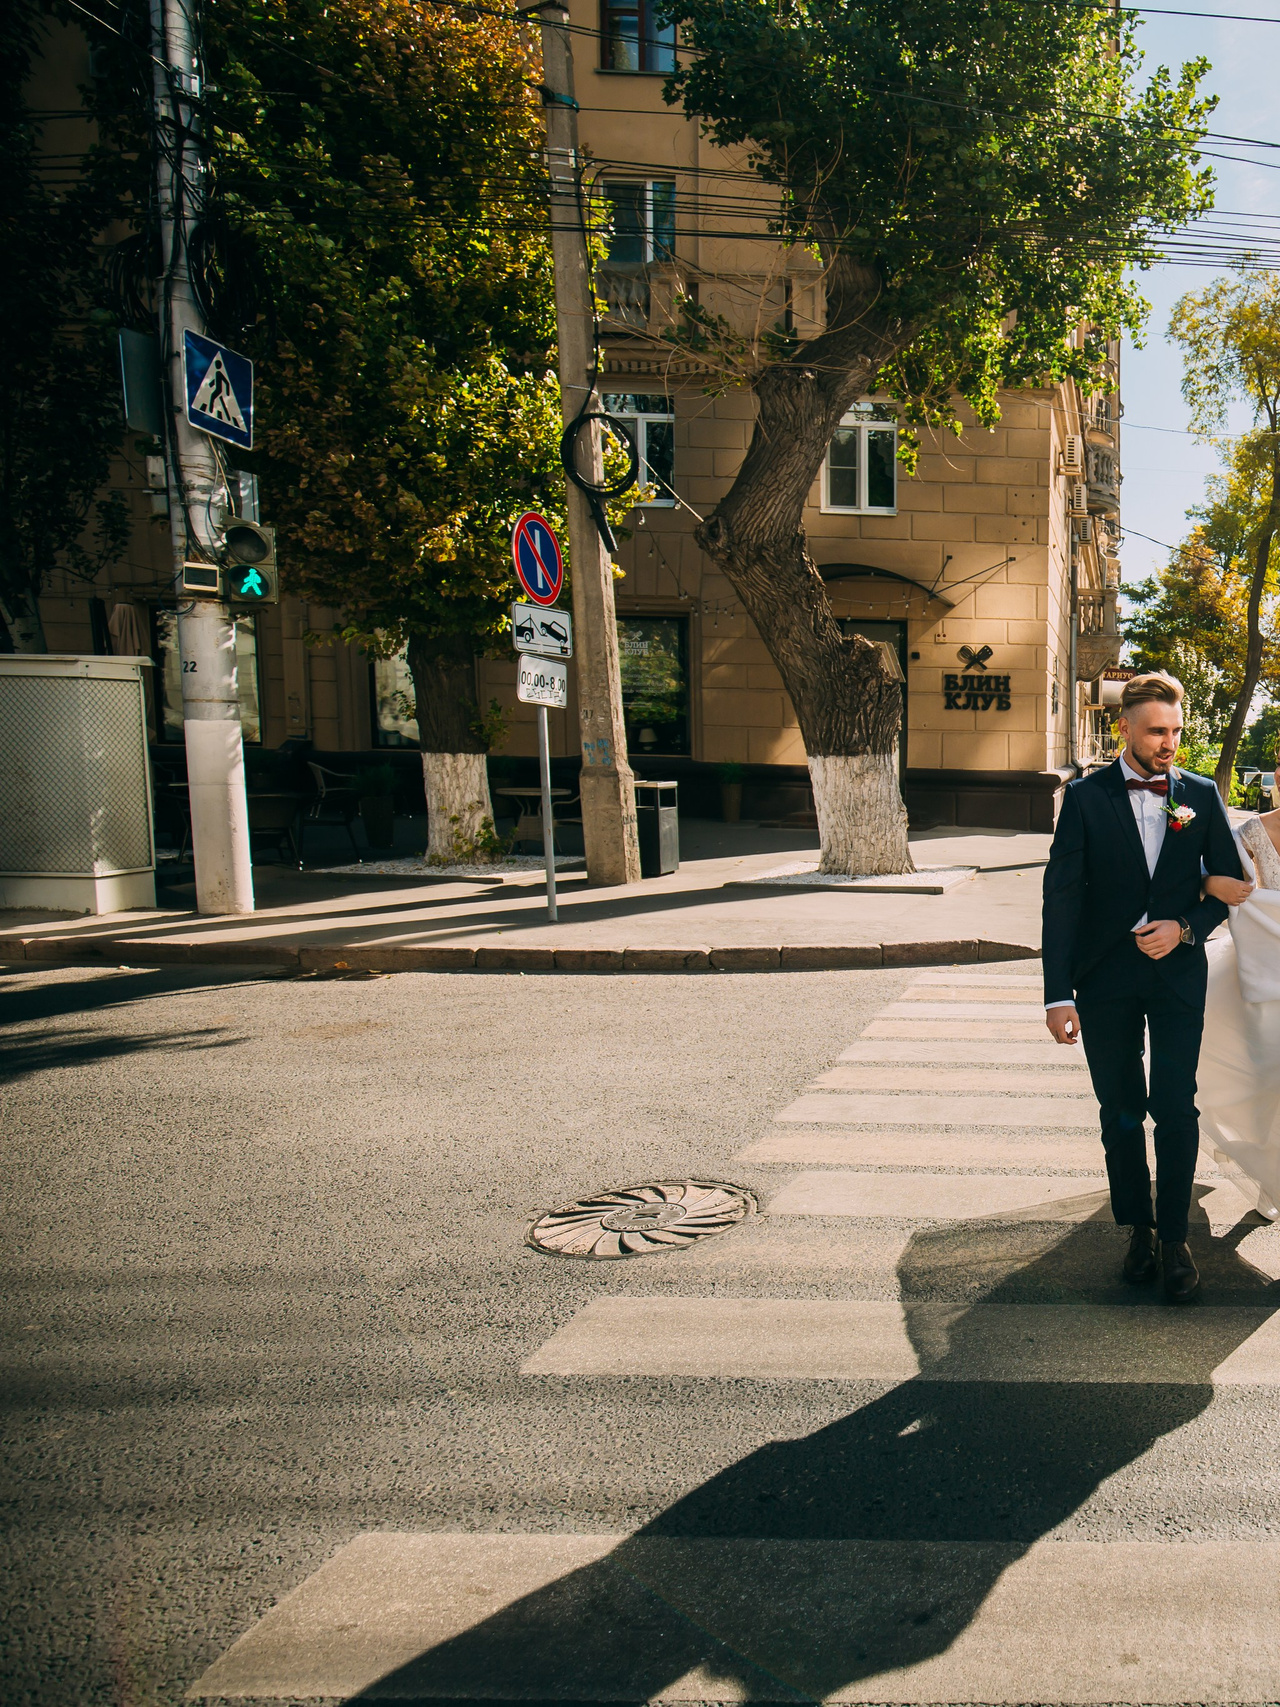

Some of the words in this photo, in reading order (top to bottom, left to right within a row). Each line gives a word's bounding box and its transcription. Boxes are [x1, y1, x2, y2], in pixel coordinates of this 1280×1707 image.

[624, 641, 648, 649] БЛИН
[183, 661, 198, 673] 22
[521, 671, 566, 693] 00.00-8.00
[944, 674, 1011, 692] БЛИН
[944, 692, 1011, 711] КЛУБ
